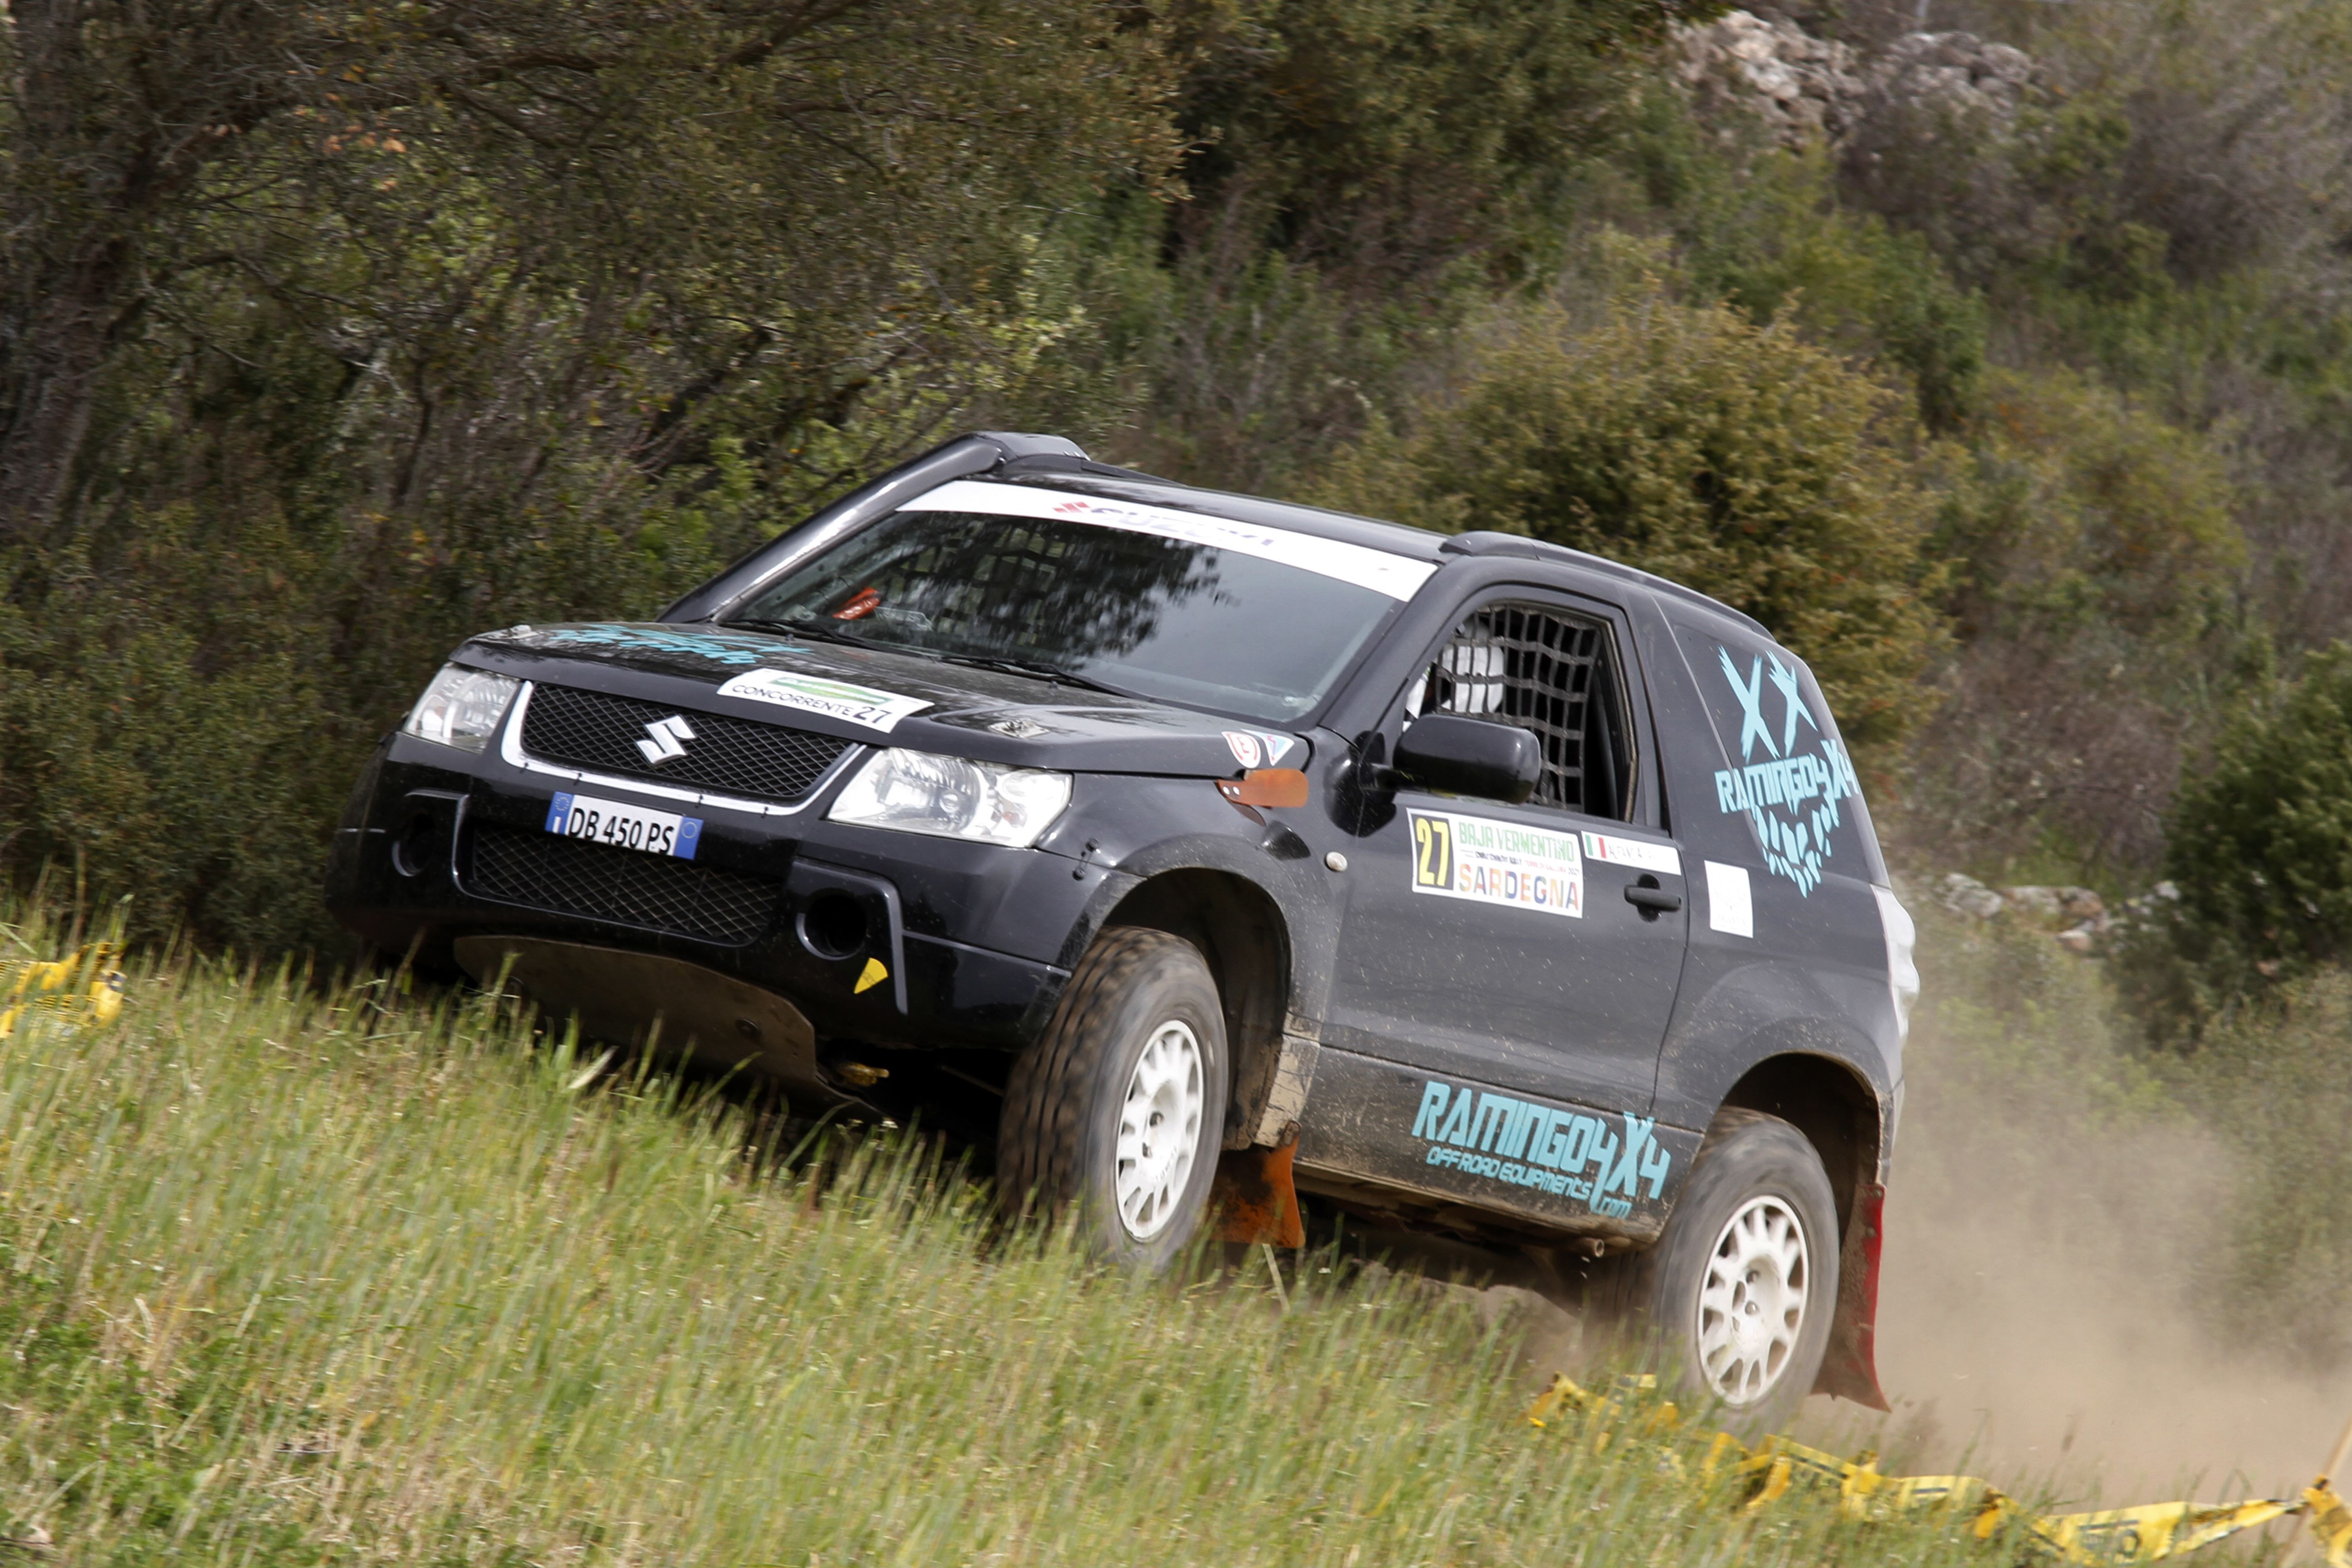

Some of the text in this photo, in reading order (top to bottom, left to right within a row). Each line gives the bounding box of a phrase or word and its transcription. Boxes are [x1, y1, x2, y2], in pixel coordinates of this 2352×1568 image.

[732, 685, 854, 716] CONCORRENTE
[853, 706, 892, 724] 27
[569, 808, 675, 855] DB 450 PS
[1416, 817, 1450, 887] 27
[1459, 821, 1494, 849] BAJA
[1496, 828, 1575, 862] VERMENTINO
[1459, 863, 1579, 911] SARDEGNA
[1411, 1080, 1671, 1212] RAMINGO4X4
